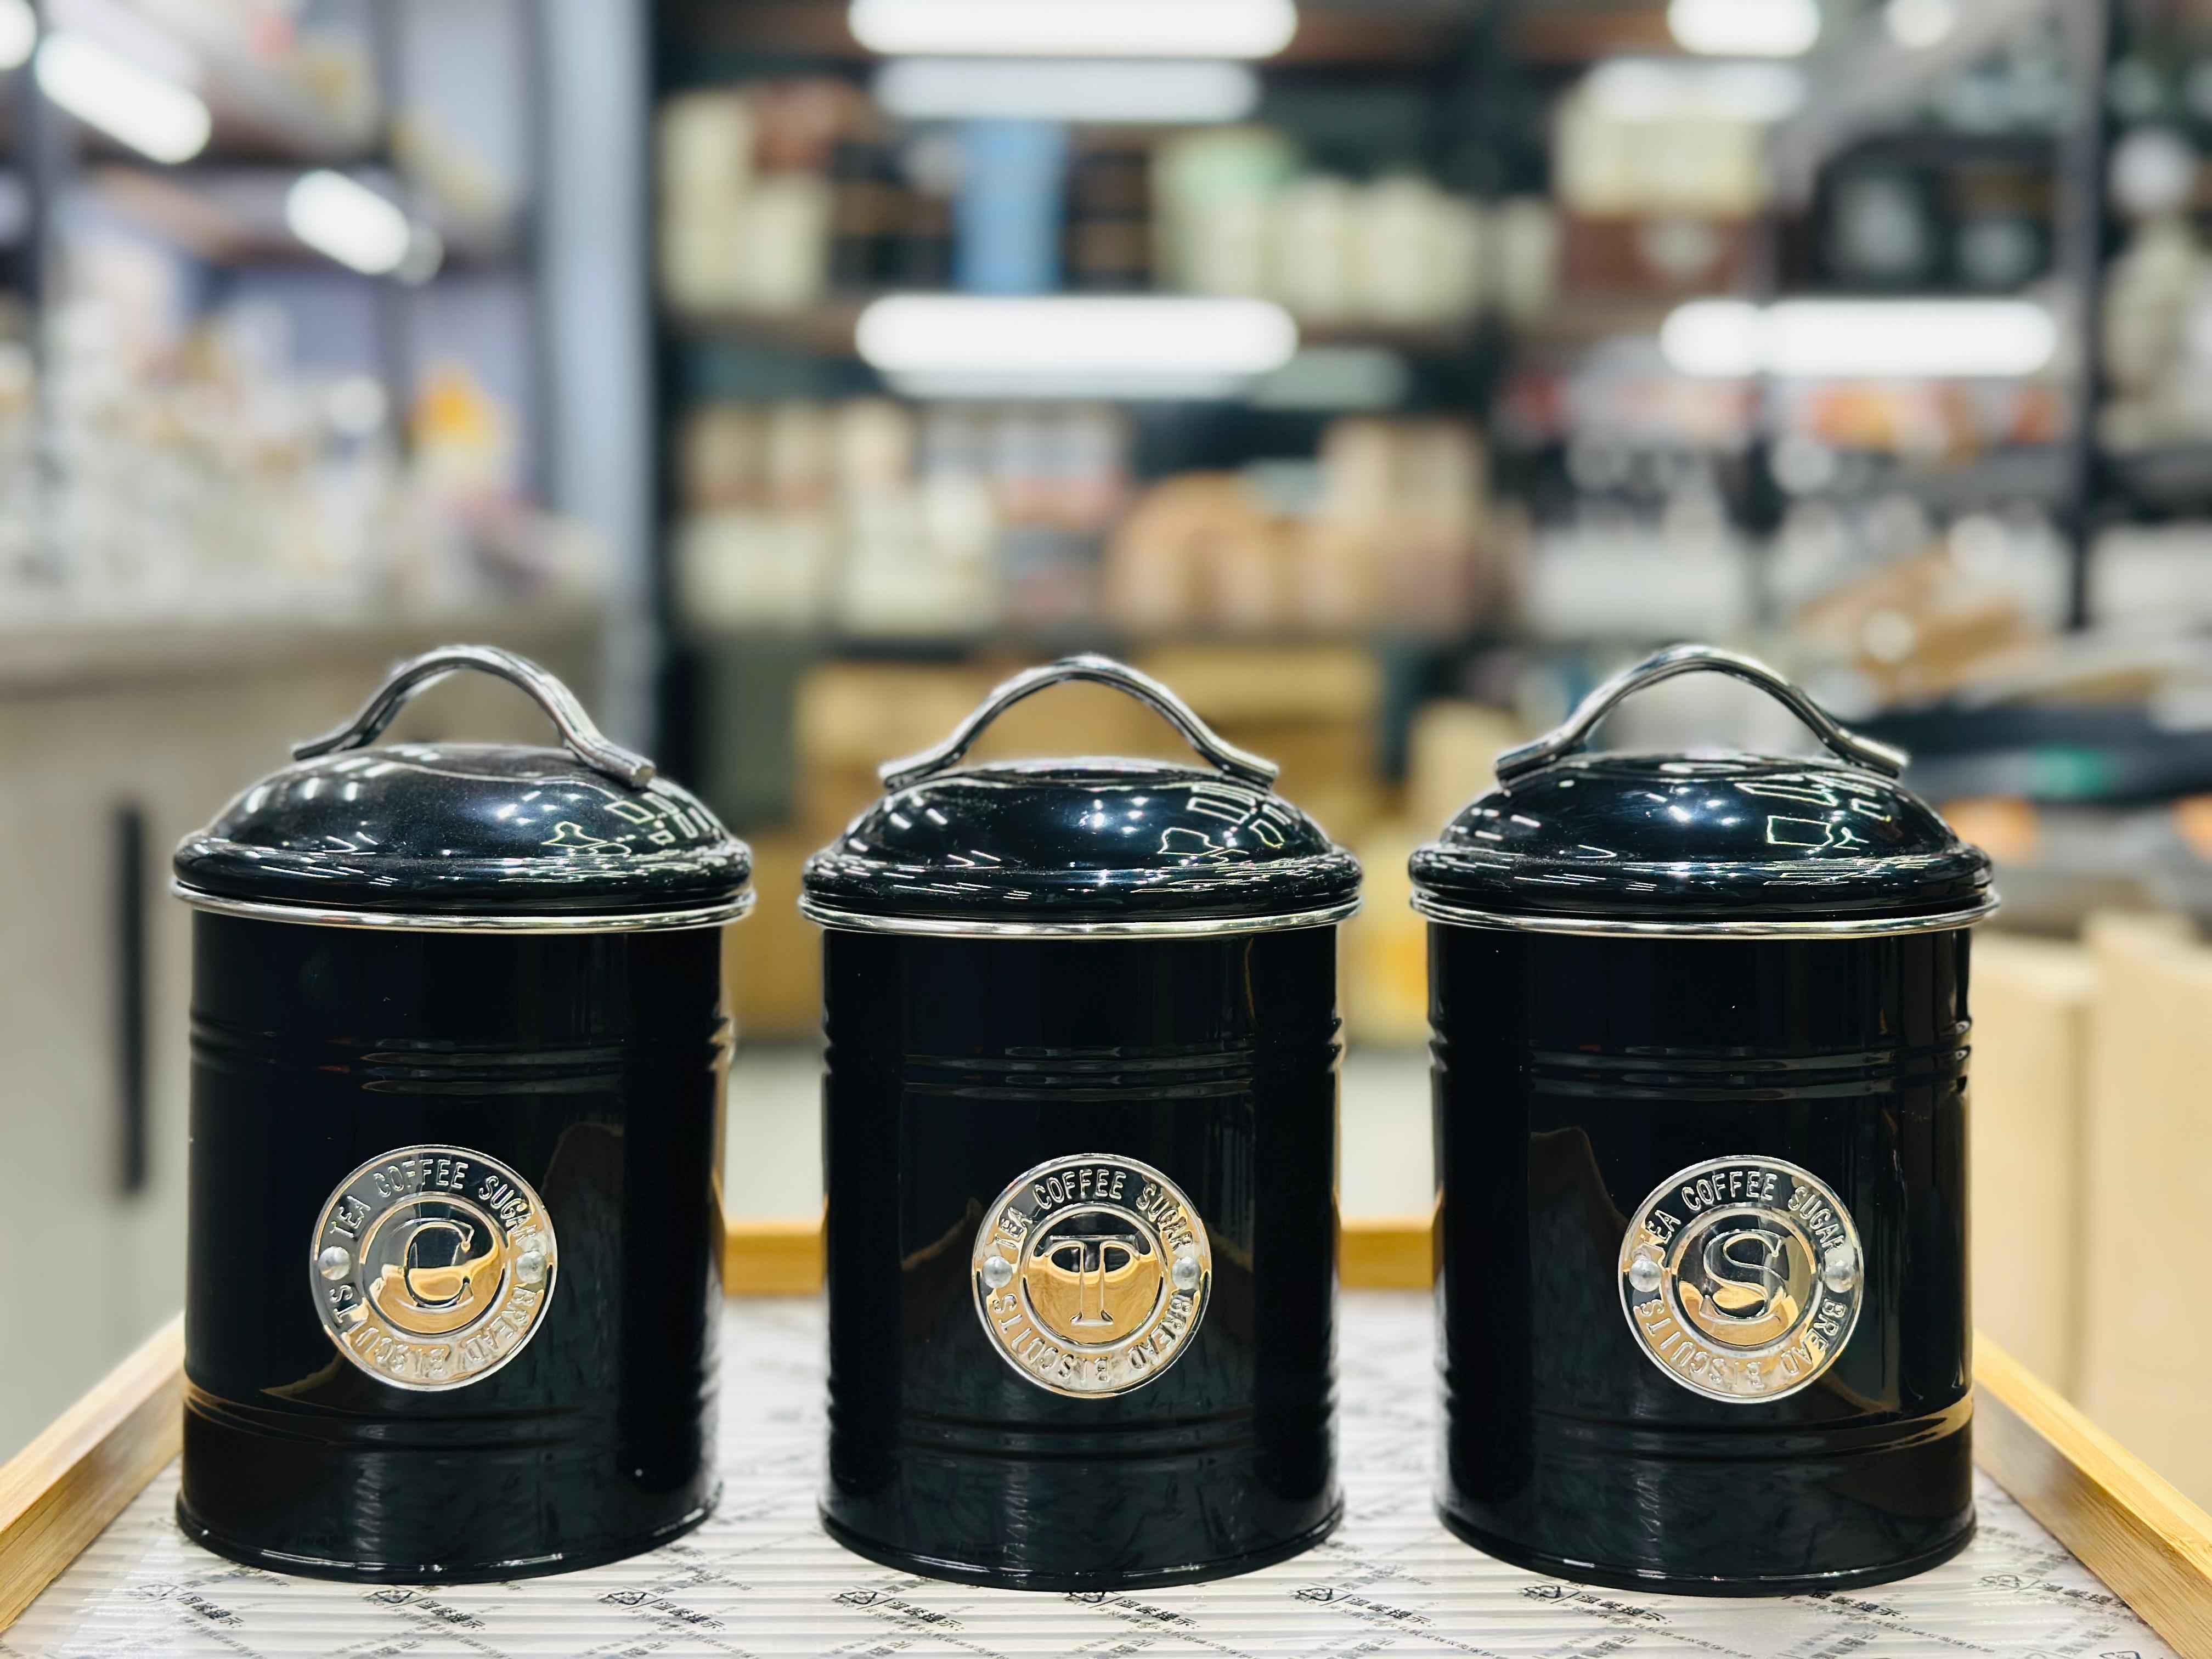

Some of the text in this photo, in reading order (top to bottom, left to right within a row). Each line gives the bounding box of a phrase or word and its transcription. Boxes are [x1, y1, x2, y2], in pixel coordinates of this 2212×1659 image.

[329, 1195, 371, 1238] TEA
[373, 1159, 469, 1198] COFFEE
[994, 1169, 1193, 1255] TEA COFFEE SUGAR
[1681, 1171, 1777, 1211] COFFEE
[1788, 1186, 1844, 1255] SUGAR
[385, 1217, 475, 1313] C
[1045, 1235, 1141, 1325] T
[1700, 1229, 1788, 1325] S
[992, 1292, 1194, 1383] BREAD BISCUITS
[1641, 1299, 1847, 1389] BREAD BISCUITS
